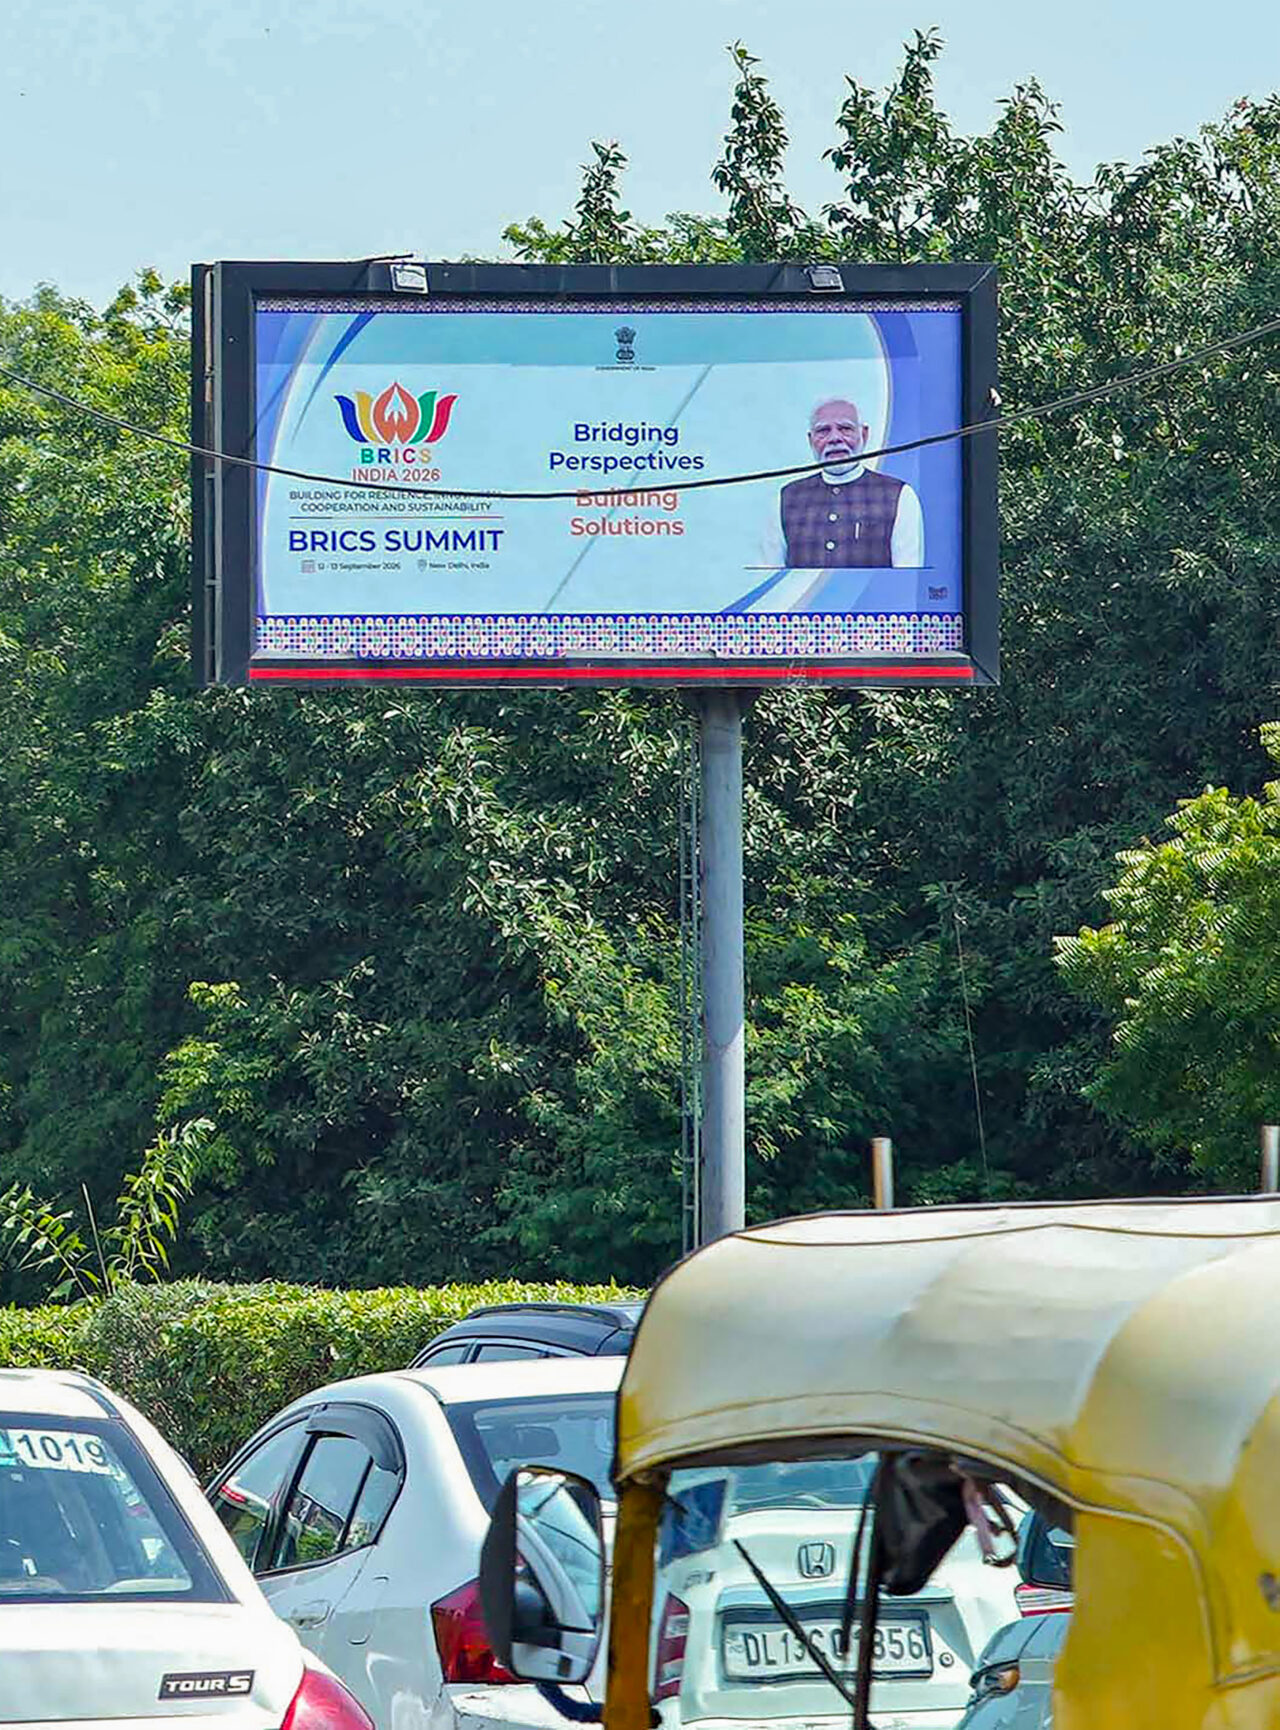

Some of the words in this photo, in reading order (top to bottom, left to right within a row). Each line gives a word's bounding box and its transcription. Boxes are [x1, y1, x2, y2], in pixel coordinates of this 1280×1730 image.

[574, 422, 679, 446] Bridging
[360, 447, 433, 464] BRICS
[549, 450, 705, 474] Perspectives
[352, 468, 399, 482] INDIA
[402, 468, 441, 482] 2026
[289, 490, 342, 500] BUILDING
[344, 490, 366, 500] FOR
[576, 487, 678, 511] Building
[300, 502, 382, 512] COOPERATION
[383, 502, 406, 512] AND
[407, 502, 493, 512] SUSTAINABILITY
[570, 516, 685, 536] Solutions
[288, 530, 376, 552] BRICS
[384, 530, 505, 552] SUMMIT
[166, 1678, 226, 1693] TOUR
[227, 1675, 251, 1693] S
